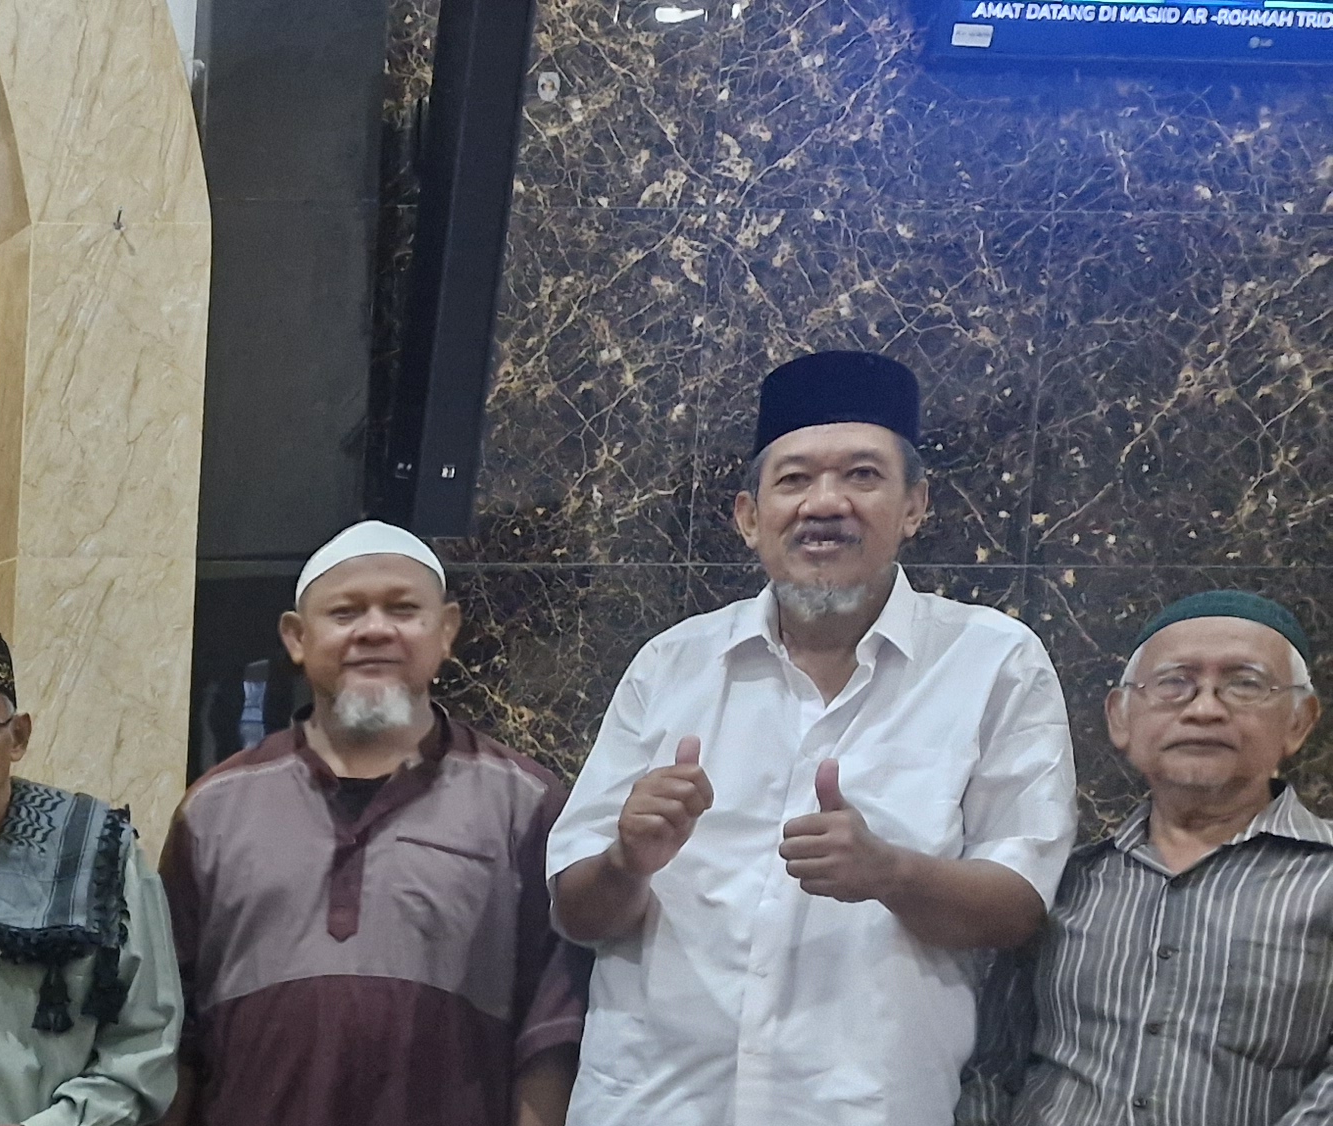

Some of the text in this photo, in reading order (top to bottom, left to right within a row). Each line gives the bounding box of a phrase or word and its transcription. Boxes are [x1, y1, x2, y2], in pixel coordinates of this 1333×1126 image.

[1026, 3, 1095, 21] DATANG
[1099, 5, 1117, 22] DI
[1182, 7, 1208, 24] AR
